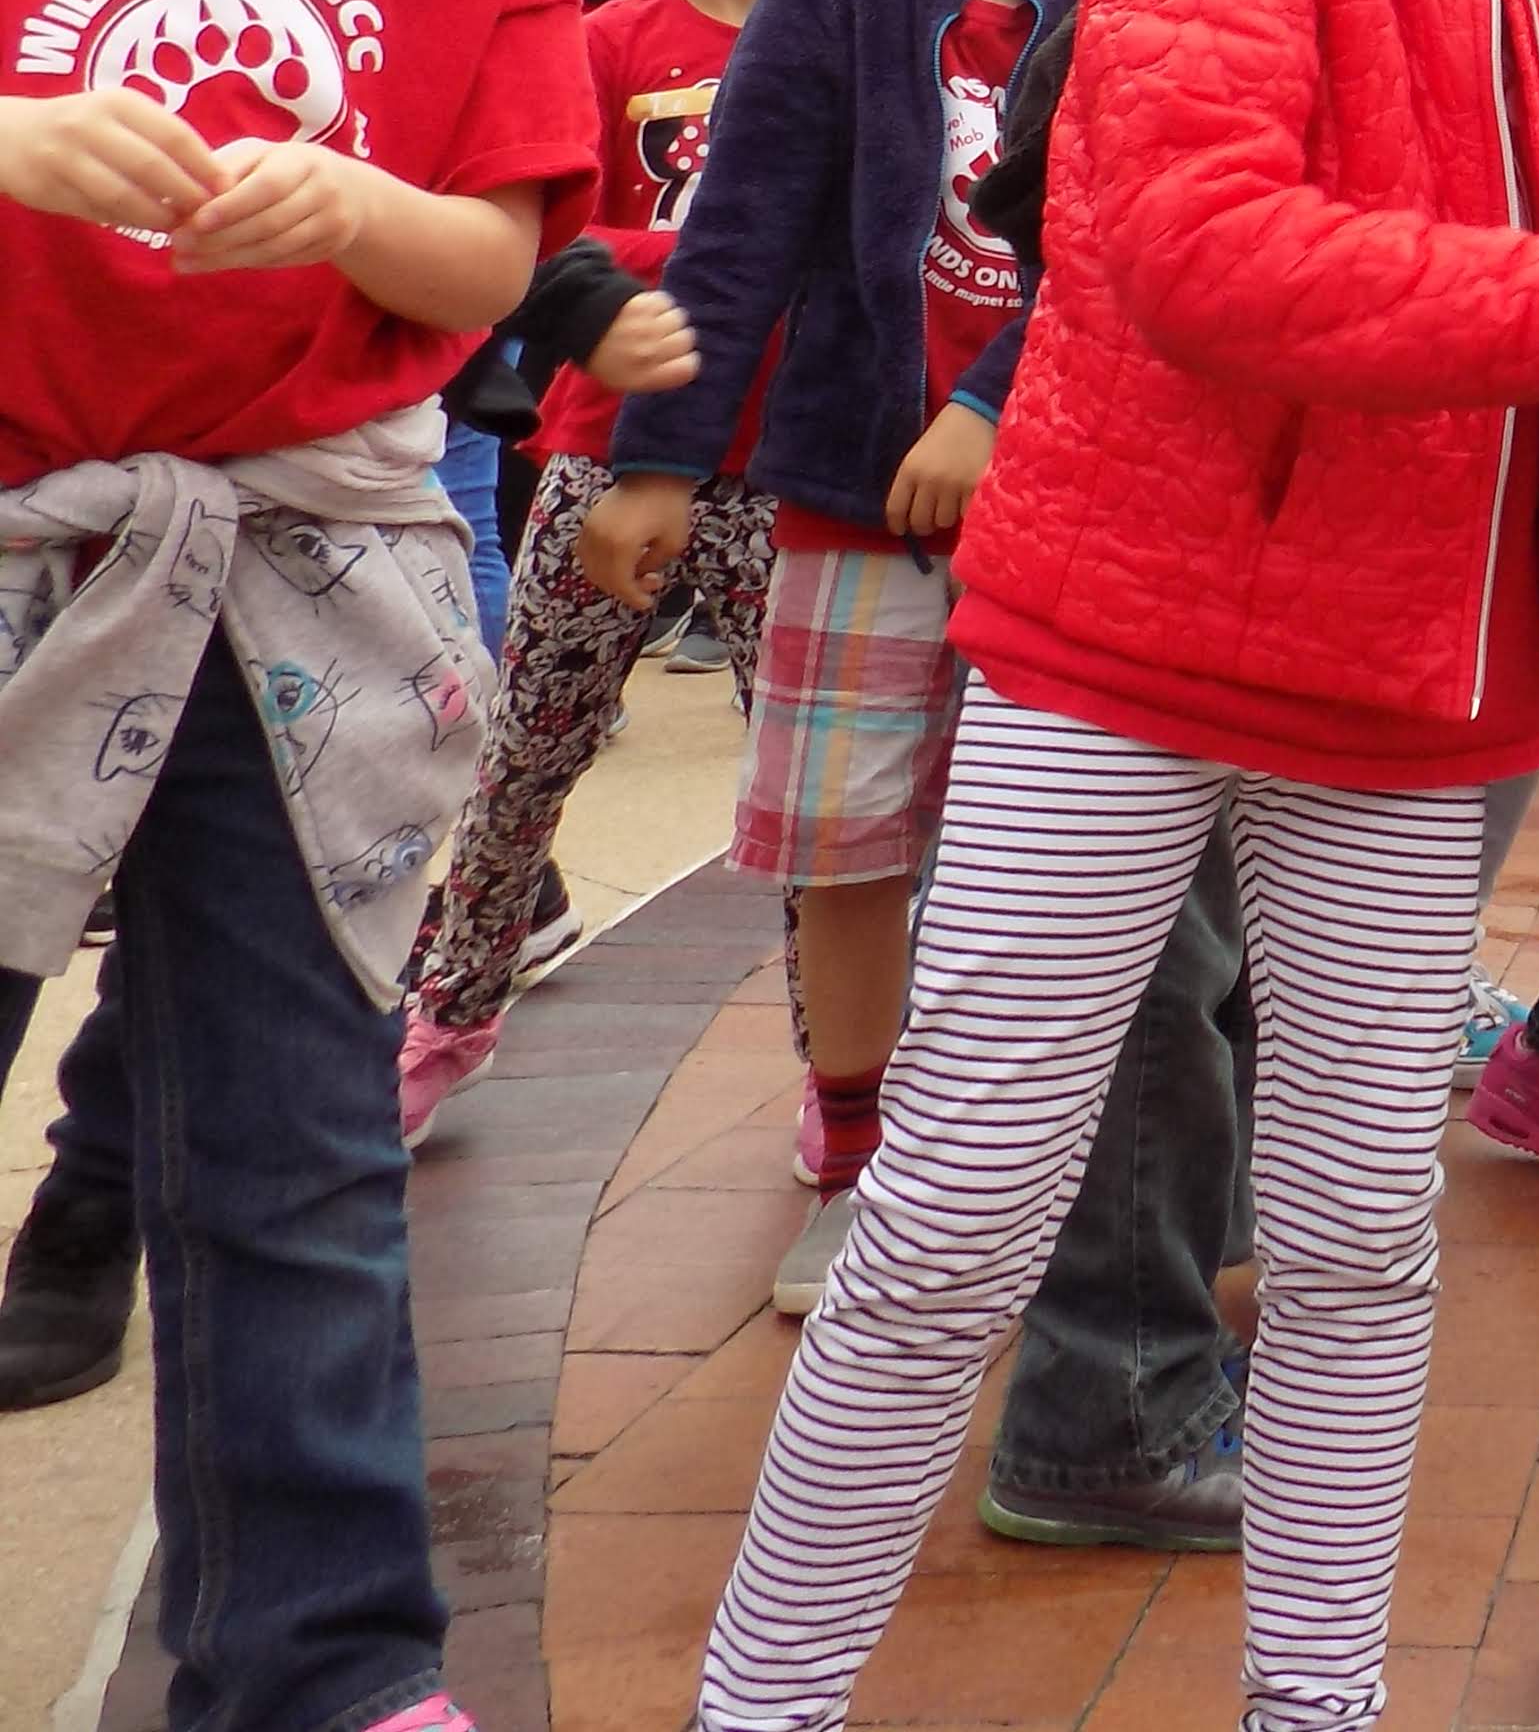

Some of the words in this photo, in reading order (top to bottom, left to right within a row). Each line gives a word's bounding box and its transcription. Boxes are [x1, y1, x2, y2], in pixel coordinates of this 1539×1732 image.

[949, 129, 985, 153] Mob
[928, 234, 974, 279] NDS
[954, 285, 1004, 308] magnet
